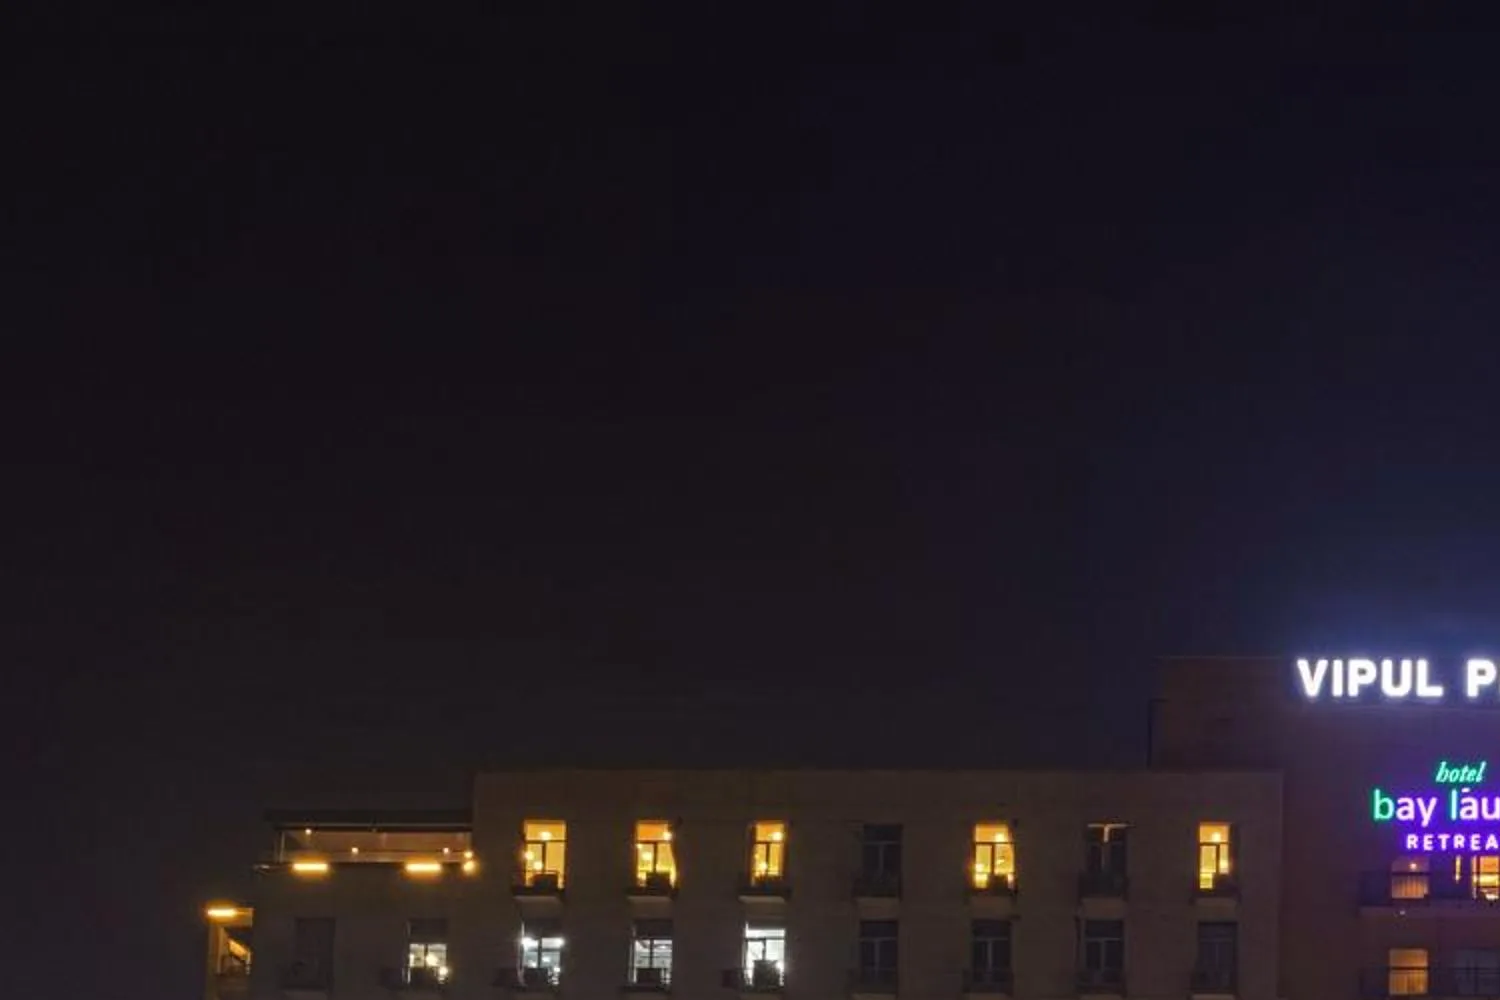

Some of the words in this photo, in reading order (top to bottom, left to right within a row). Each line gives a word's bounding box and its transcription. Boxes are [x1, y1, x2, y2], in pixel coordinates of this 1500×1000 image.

[1297, 658, 1444, 698] VIPUL
[1435, 761, 1487, 783] hotel
[1373, 789, 1437, 828] bay
